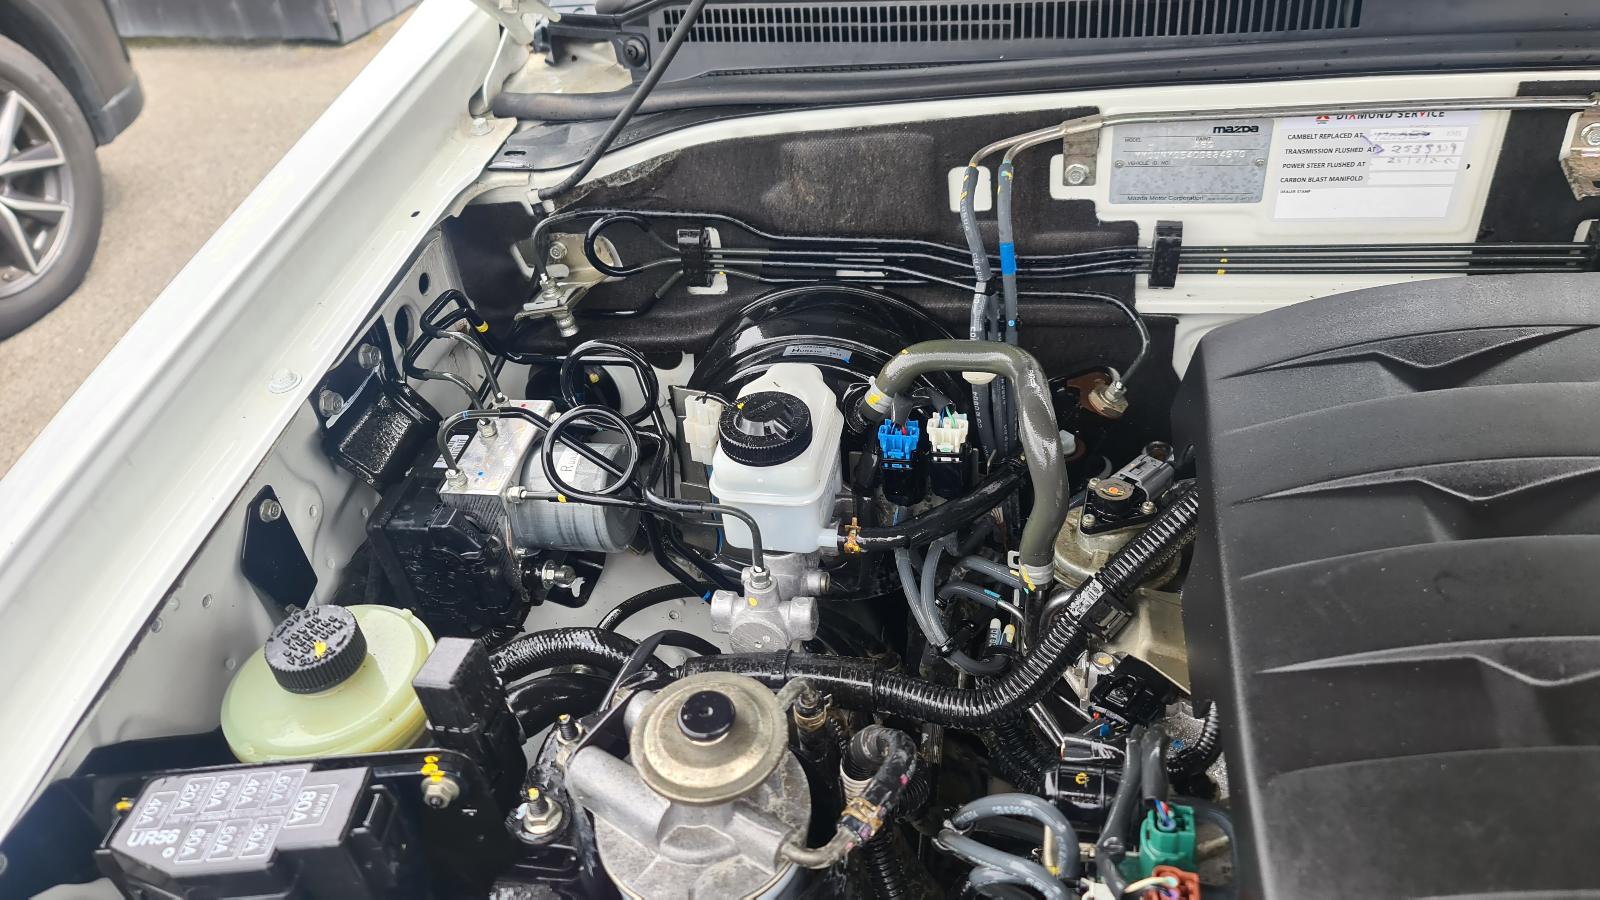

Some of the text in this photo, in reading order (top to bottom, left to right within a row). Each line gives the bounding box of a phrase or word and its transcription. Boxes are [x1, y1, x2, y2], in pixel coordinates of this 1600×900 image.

[177, 783, 201, 811] 20A
[206, 781, 231, 809] 60A
[237, 778, 260, 805] 40A
[137, 798, 161, 825] 40A
[289, 790, 318, 823] 80A
[126, 829, 181, 847] UR56
